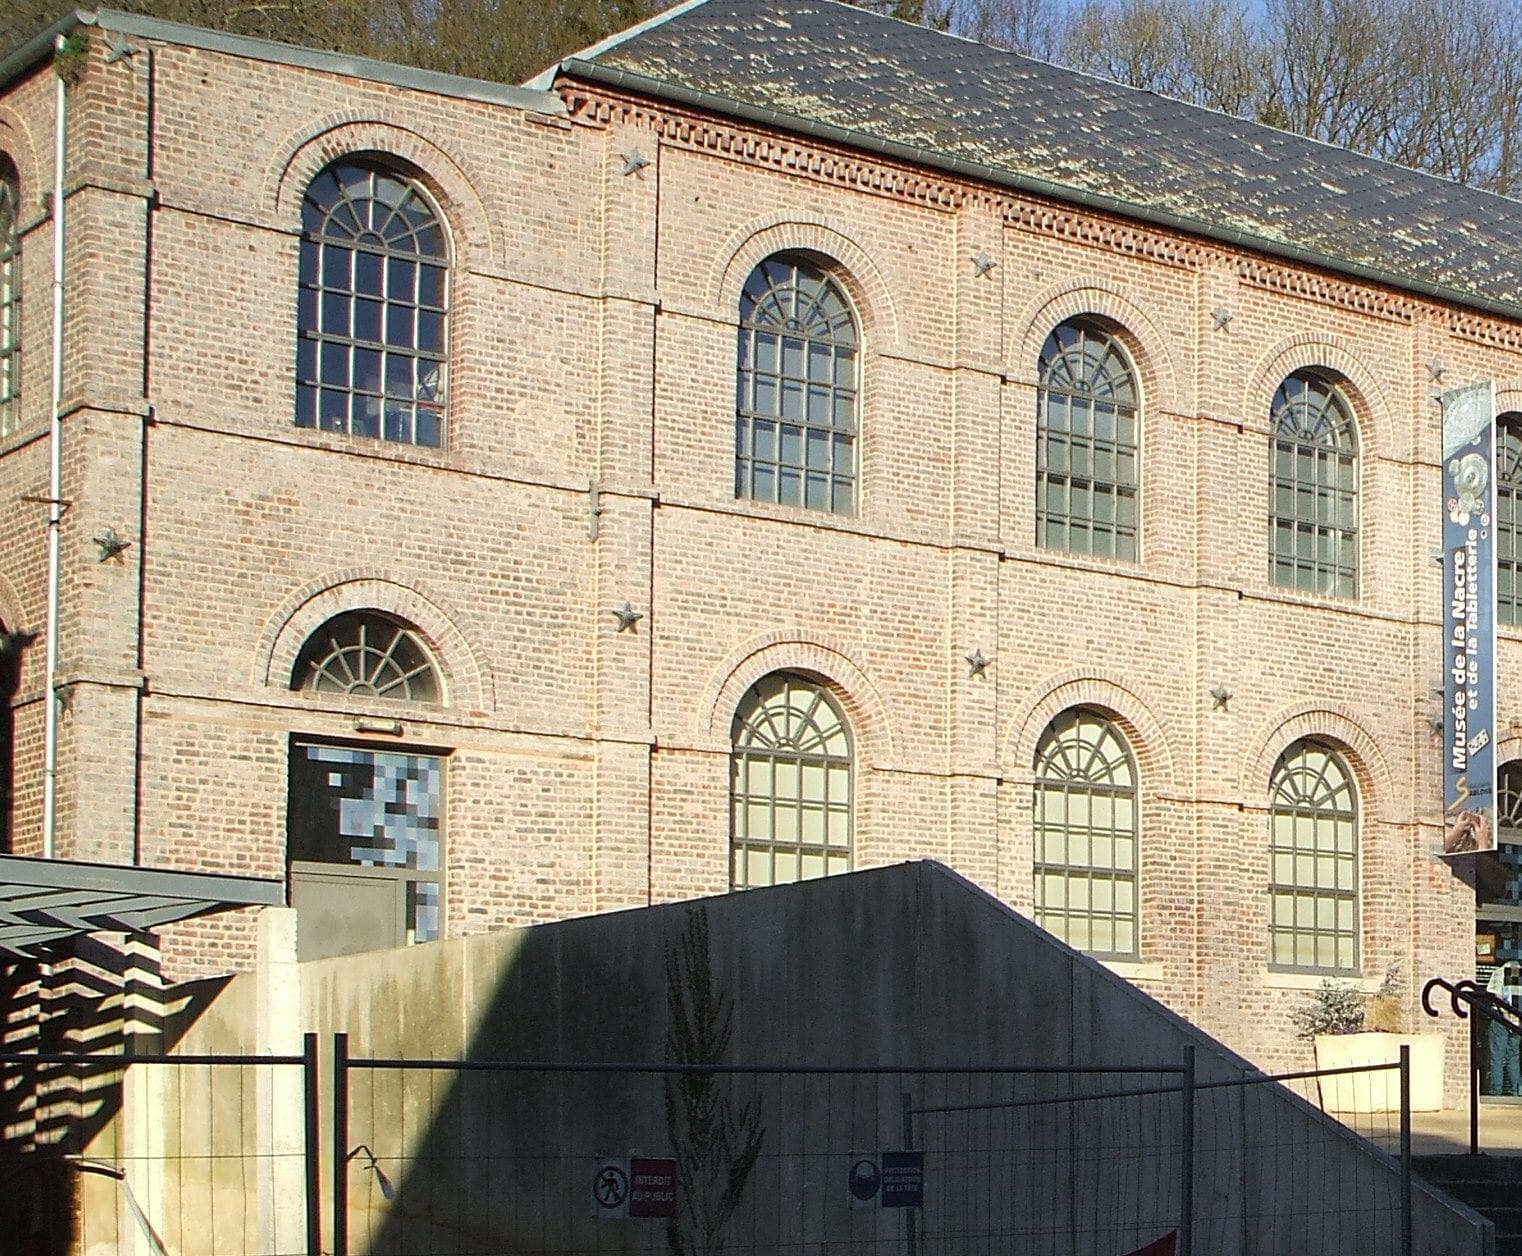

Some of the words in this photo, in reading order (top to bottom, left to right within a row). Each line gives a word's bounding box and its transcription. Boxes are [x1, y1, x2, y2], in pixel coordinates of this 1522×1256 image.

[1452, 550, 1466, 618] Nacre
[1466, 529, 1478, 632] Tabletterie
[1452, 628, 1465, 647] la
[1466, 637, 1478, 656] la
[1452, 654, 1466, 685] de
[1467, 660, 1478, 685] de
[1468, 689, 1478, 710] et
[1452, 691, 1466, 769] Musée
[634, 1175, 672, 1186] INTERDIT
[645, 1191, 674, 1201] PUBLIC
